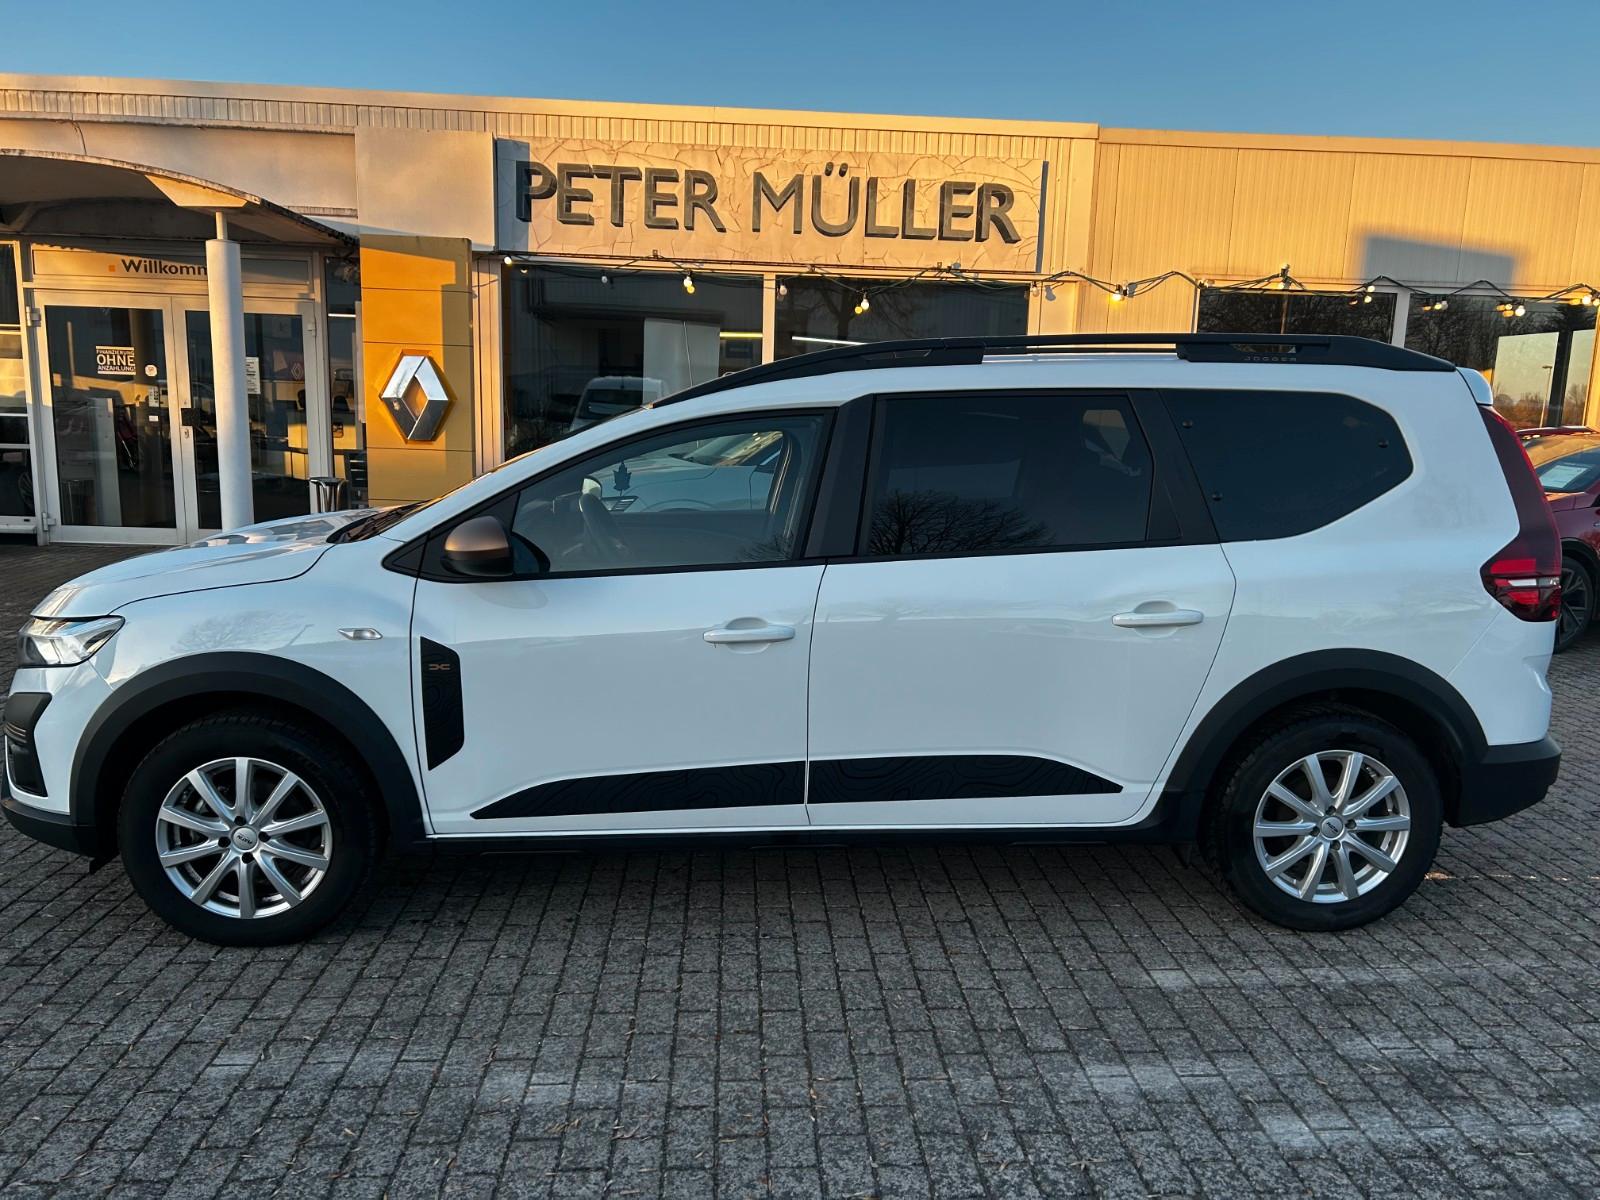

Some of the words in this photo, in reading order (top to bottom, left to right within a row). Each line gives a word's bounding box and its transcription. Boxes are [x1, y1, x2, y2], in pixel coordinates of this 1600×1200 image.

[516, 160, 727, 233] PETER
[752, 161, 1021, 244] MÜLLER
[96, 354, 136, 366] OHNE
